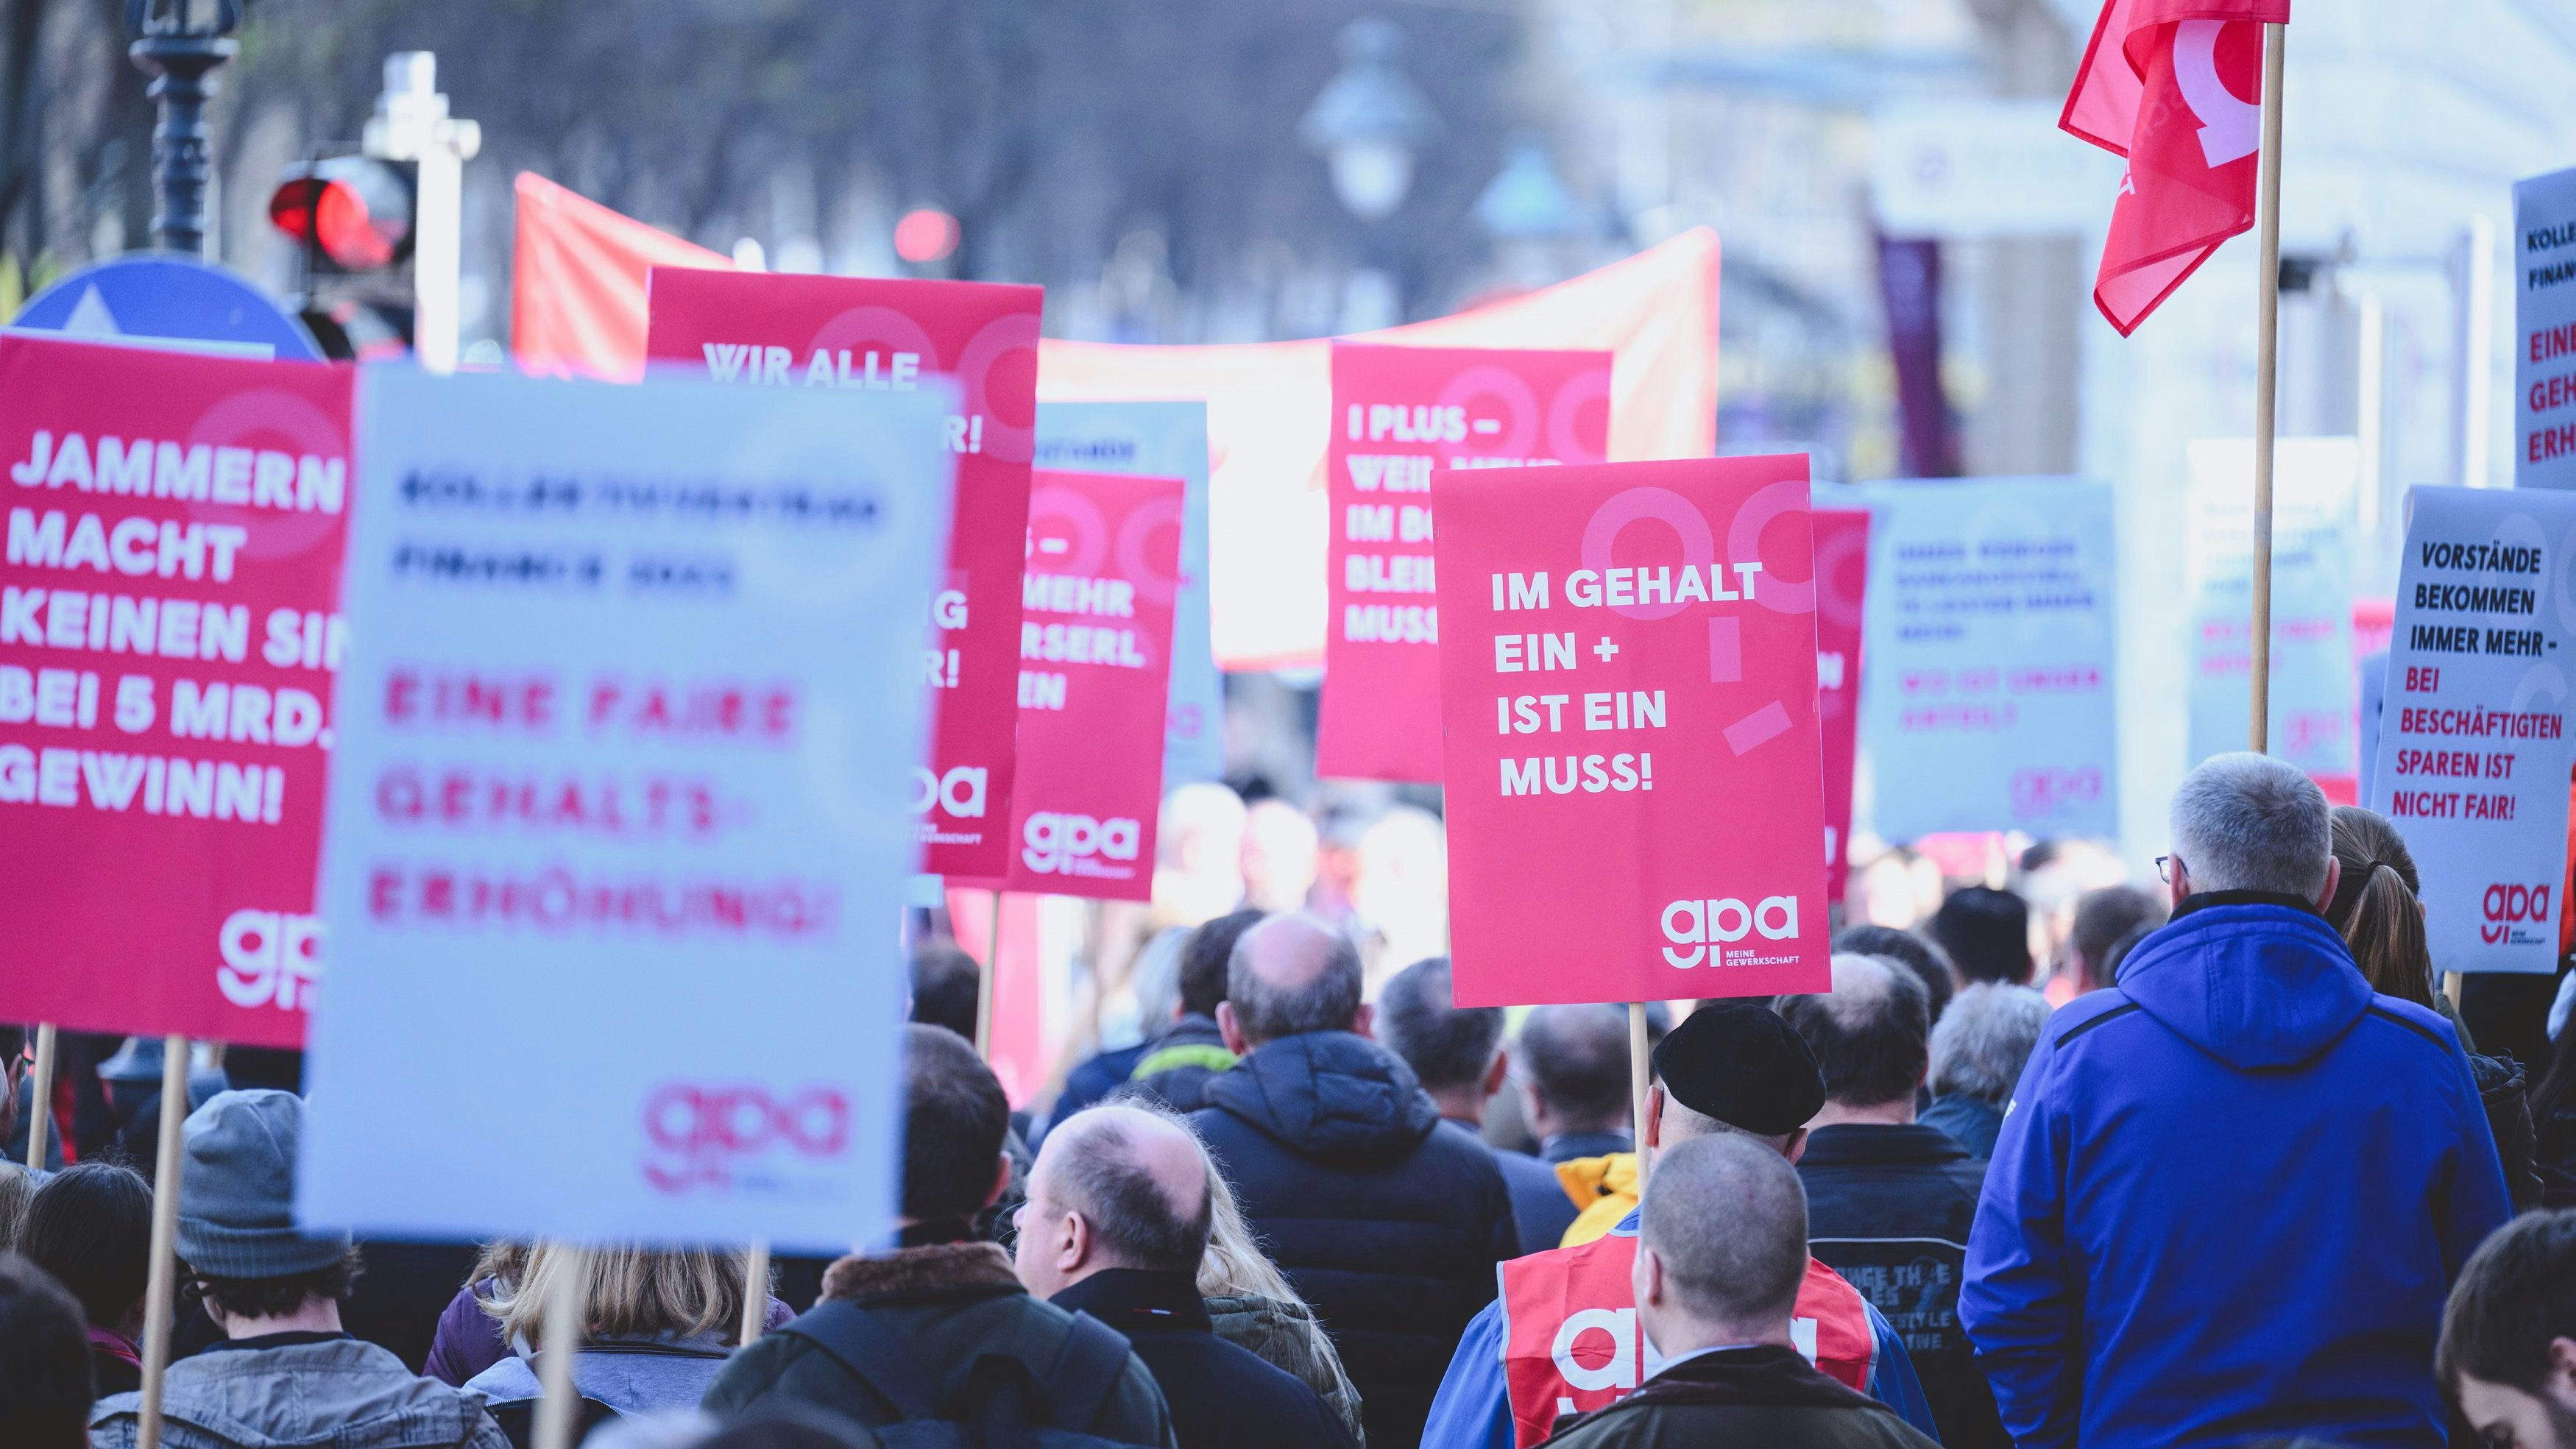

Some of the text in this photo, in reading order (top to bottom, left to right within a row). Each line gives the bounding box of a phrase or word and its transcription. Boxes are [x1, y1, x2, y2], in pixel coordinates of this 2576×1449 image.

[702, 342, 920, 392] WIR ALLE
[1369, 404, 1468, 443] PLUS
[10, 431, 346, 513] JAMMERN
[1346, 503, 1394, 542] IM
[6, 509, 247, 582] MACHT
[2421, 540, 2541, 573] VORSTÄNDE
[1491, 562, 1763, 611] IM GEHALT
[2415, 583, 2536, 614] BEKOMMEN
[0, 586, 250, 664] KEINEN
[2410, 624, 2479, 654] IMMER
[2485, 628, 2544, 657] MEHR
[1494, 633, 1619, 673] EIN +
[2405, 666, 2440, 692] BEI
[0, 665, 337, 752] BEI 5 MRD.
[383, 667, 796, 740] EINE FAIRE
[1497, 690, 1666, 734] IST EIN
[2400, 704, 2563, 740] BESCHÄFTIGTEN
[0, 743, 285, 824] GEWINN!
[1500, 753, 1652, 796] MUSS!
[2396, 748, 2516, 779] SPAREN IST
[2393, 790, 2516, 821] NICHT FAIR!
[1022, 812, 1141, 875] gpa
[1661, 896, 1799, 969] gpa
[2481, 883, 2550, 945] gpa
[1726, 949, 1755, 958] MEINE
[1726, 956, 1800, 967] GEWERKSCHAFT
[643, 1082, 852, 1194] gpa
